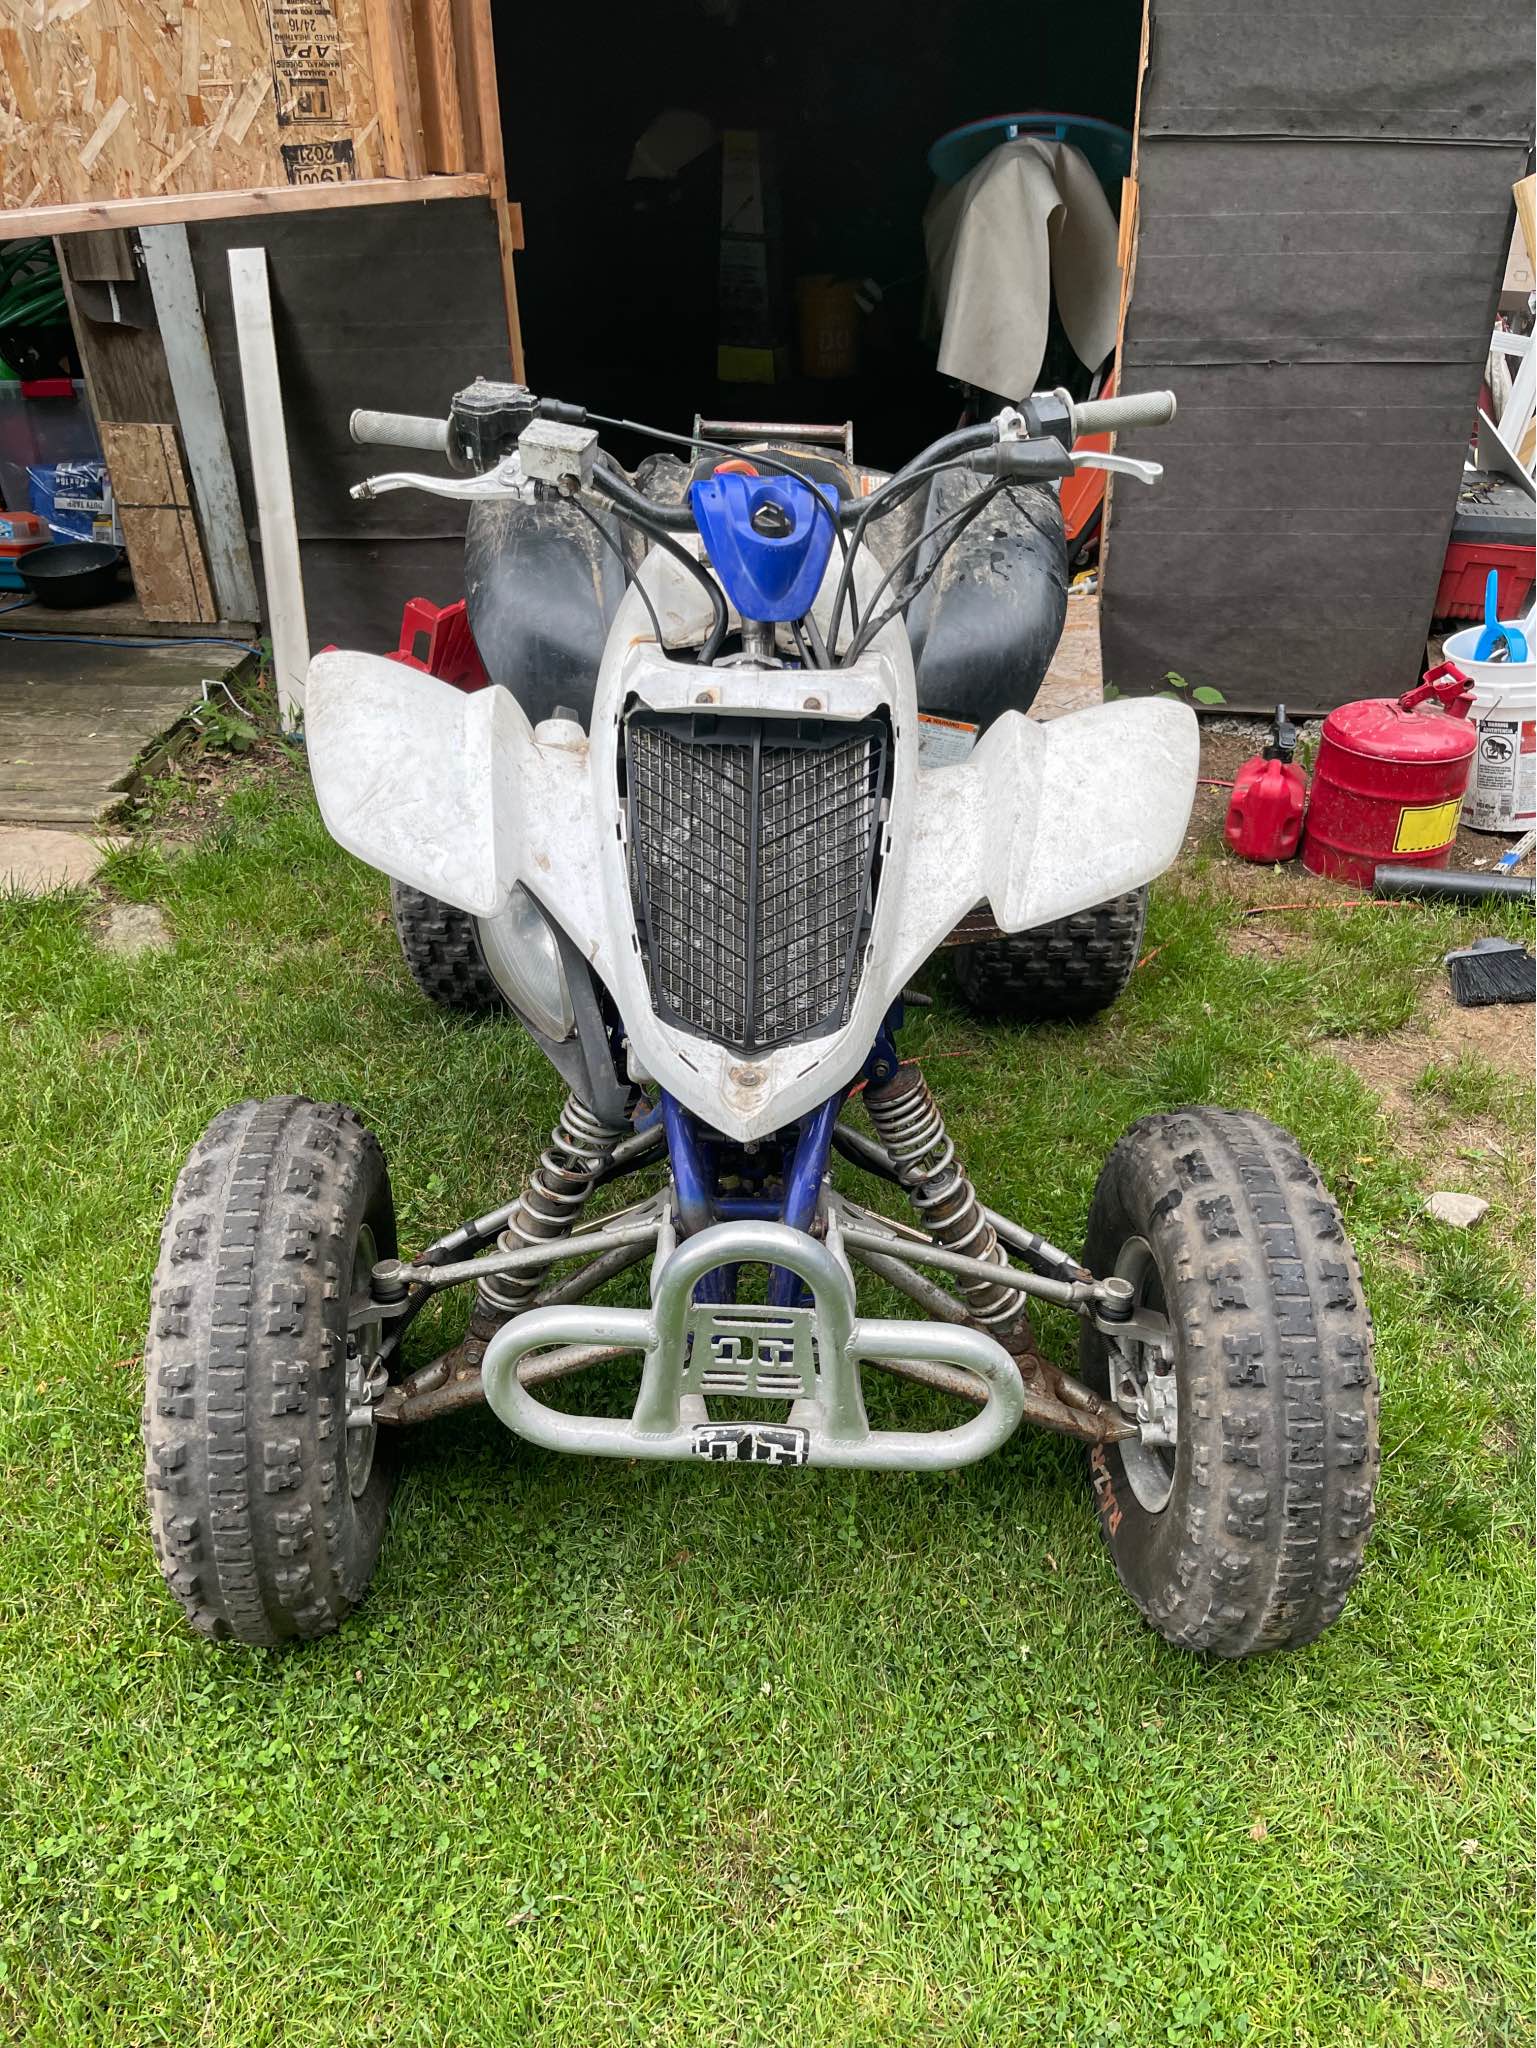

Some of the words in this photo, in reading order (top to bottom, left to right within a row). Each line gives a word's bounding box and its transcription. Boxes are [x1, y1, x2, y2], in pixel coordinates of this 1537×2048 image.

[289, 19, 316, 32] 24/16
[282, 44, 330, 58] APA
[300, 146, 333, 162] 2021
[86, 500, 103, 510] DUTY
[932, 718, 960, 729] WARNING
